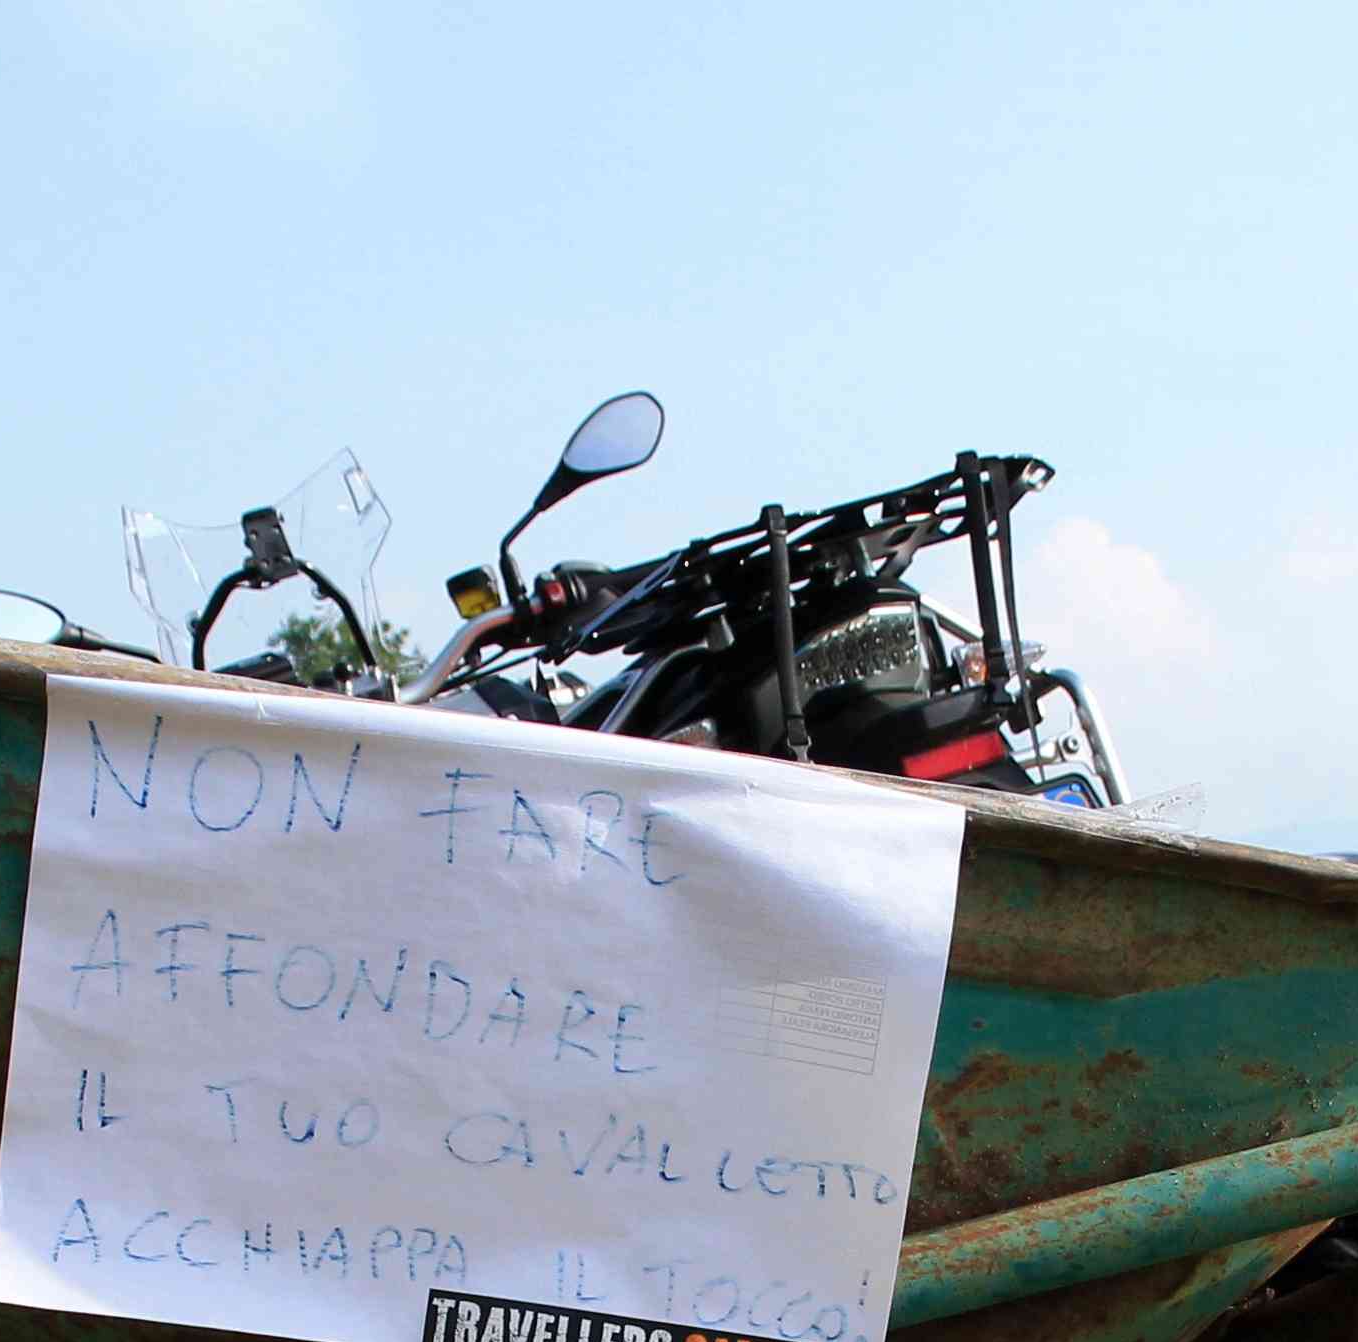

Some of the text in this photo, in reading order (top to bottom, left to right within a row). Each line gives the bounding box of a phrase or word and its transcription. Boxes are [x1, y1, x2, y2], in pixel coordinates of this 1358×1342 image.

[88, 714, 688, 887] NON FARE
[71, 908, 659, 1075] AFFONDARE
[74, 1068, 898, 1205] IL TUO CAVALLETTO
[52, 1198, 467, 1284] ACCHIAPPA
[554, 1249, 607, 1301] IL
